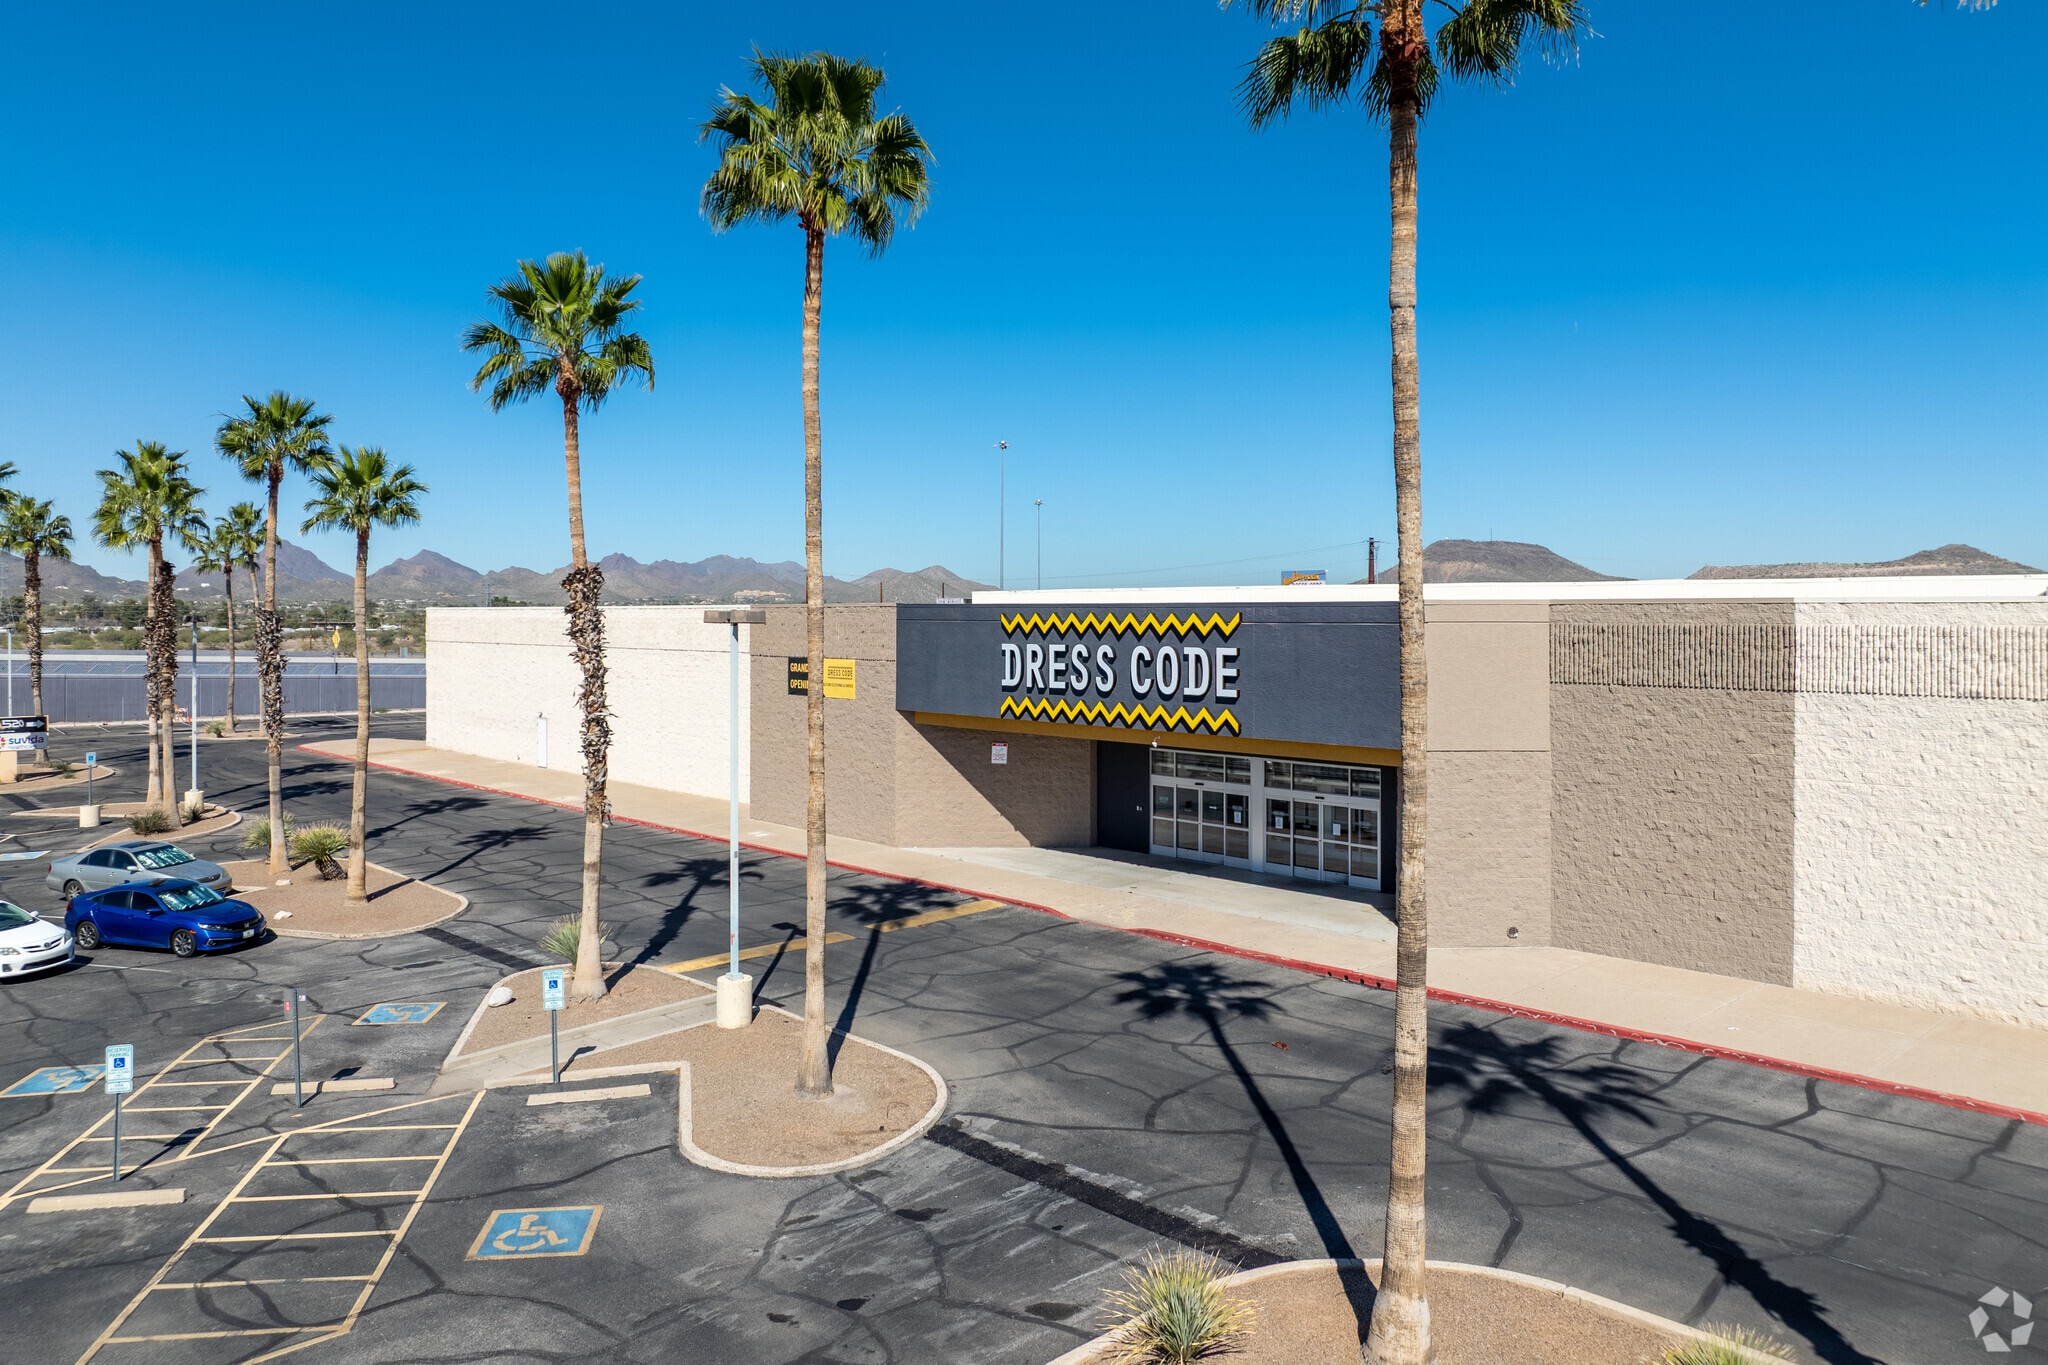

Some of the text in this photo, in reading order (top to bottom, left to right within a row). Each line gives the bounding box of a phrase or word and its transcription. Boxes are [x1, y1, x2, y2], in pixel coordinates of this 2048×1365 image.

[790, 662, 808, 672] GRAND
[1001, 643, 1238, 698] DRESS CODE
[827, 668, 853, 678] DRESS CODE
[790, 679, 808, 689] OPENI
[8, 735, 45, 745] suvida
